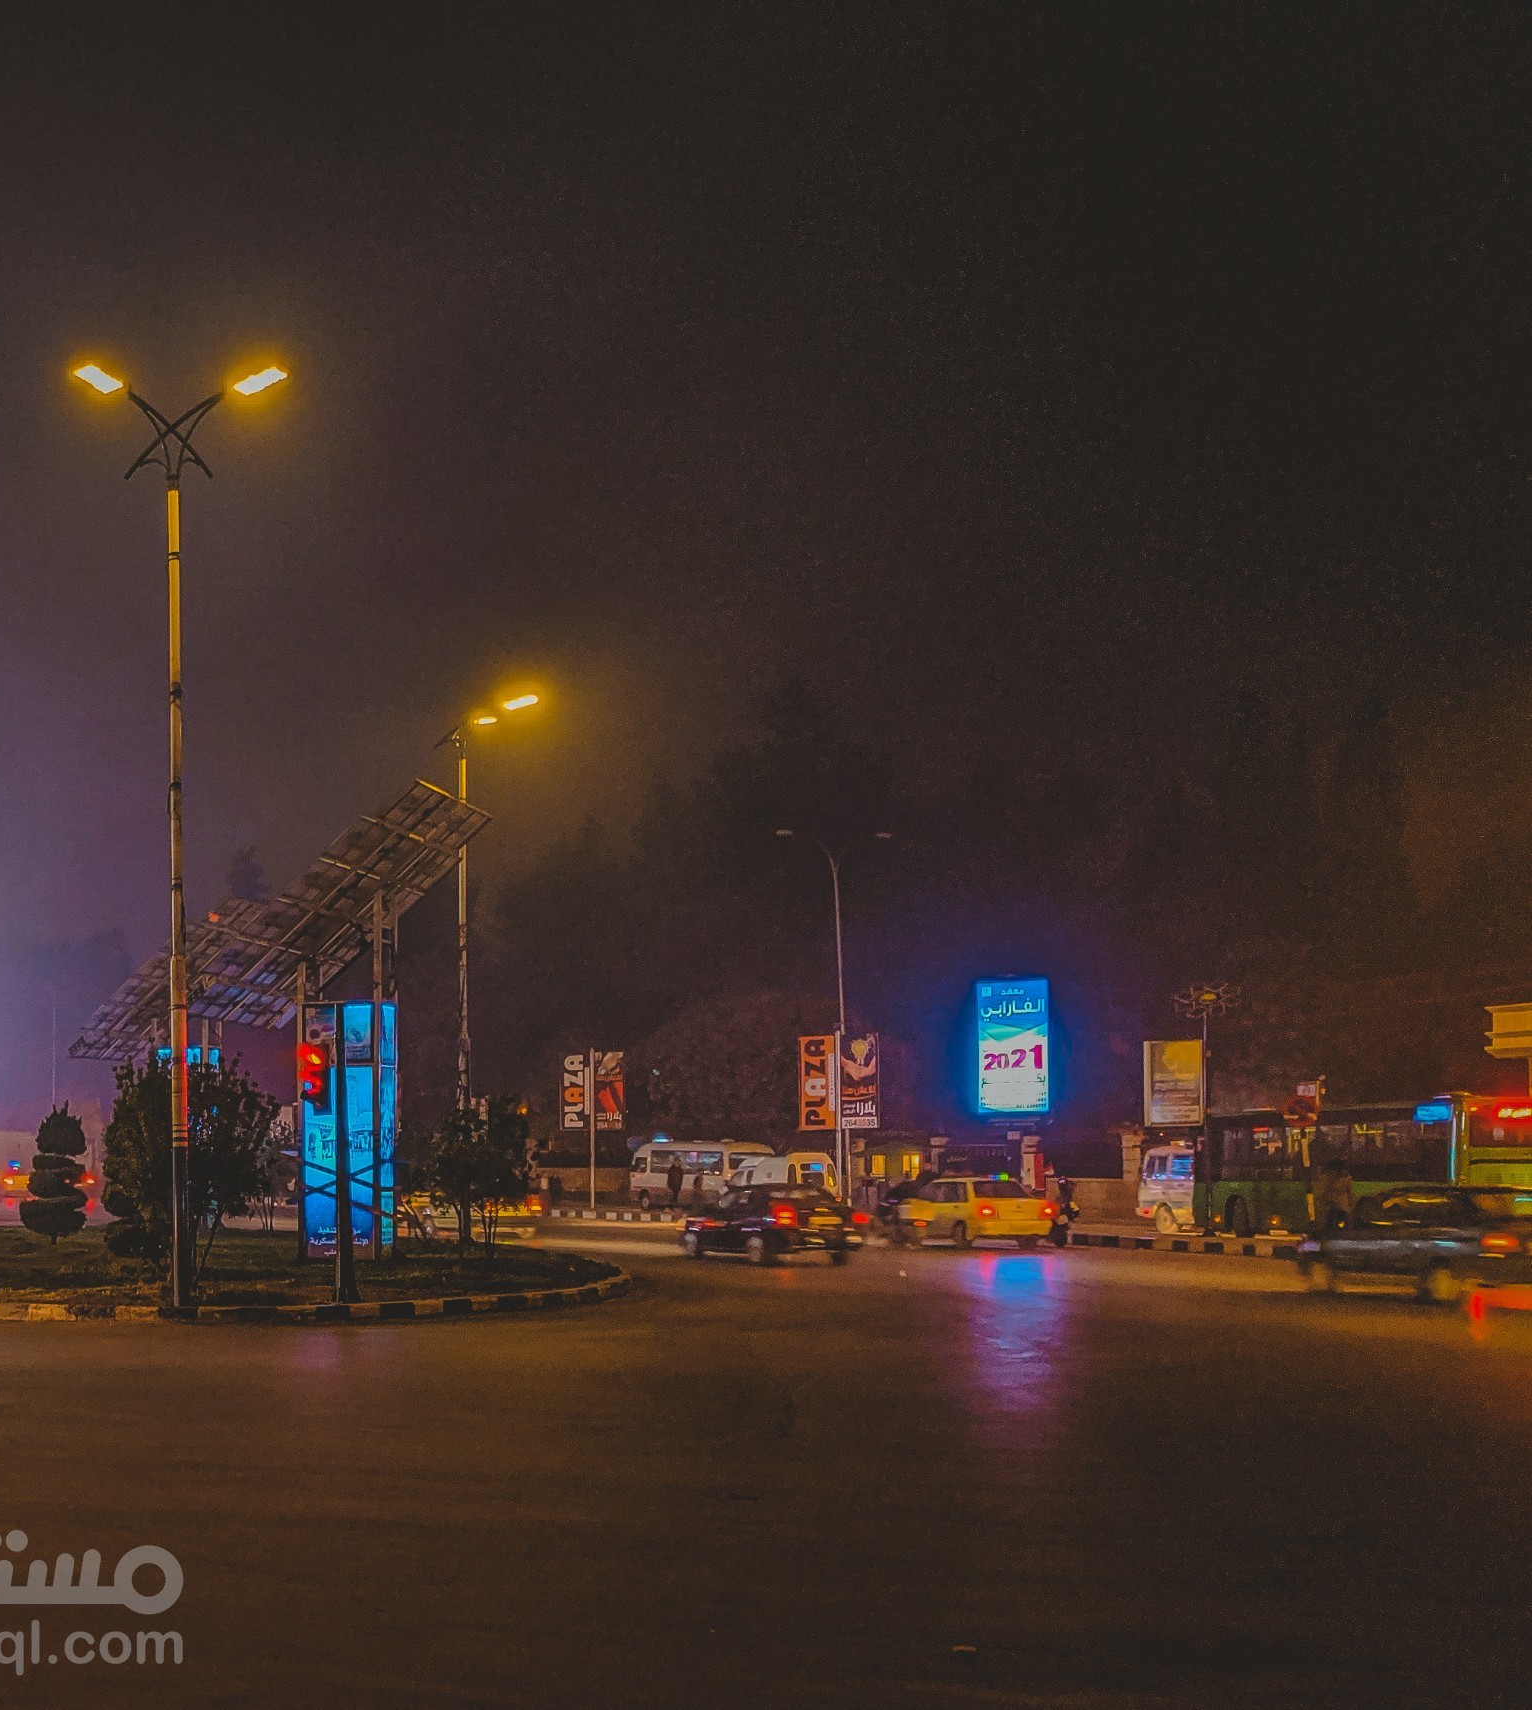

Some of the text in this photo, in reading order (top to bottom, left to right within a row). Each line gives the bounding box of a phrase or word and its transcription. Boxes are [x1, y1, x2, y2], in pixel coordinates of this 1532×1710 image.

[980, 997, 1045, 1021] الفارابي
[804, 1039, 826, 1126] PLAZA
[984, 1044, 1043, 1071] 2021
[564, 1055, 583, 1128] PLAZA
